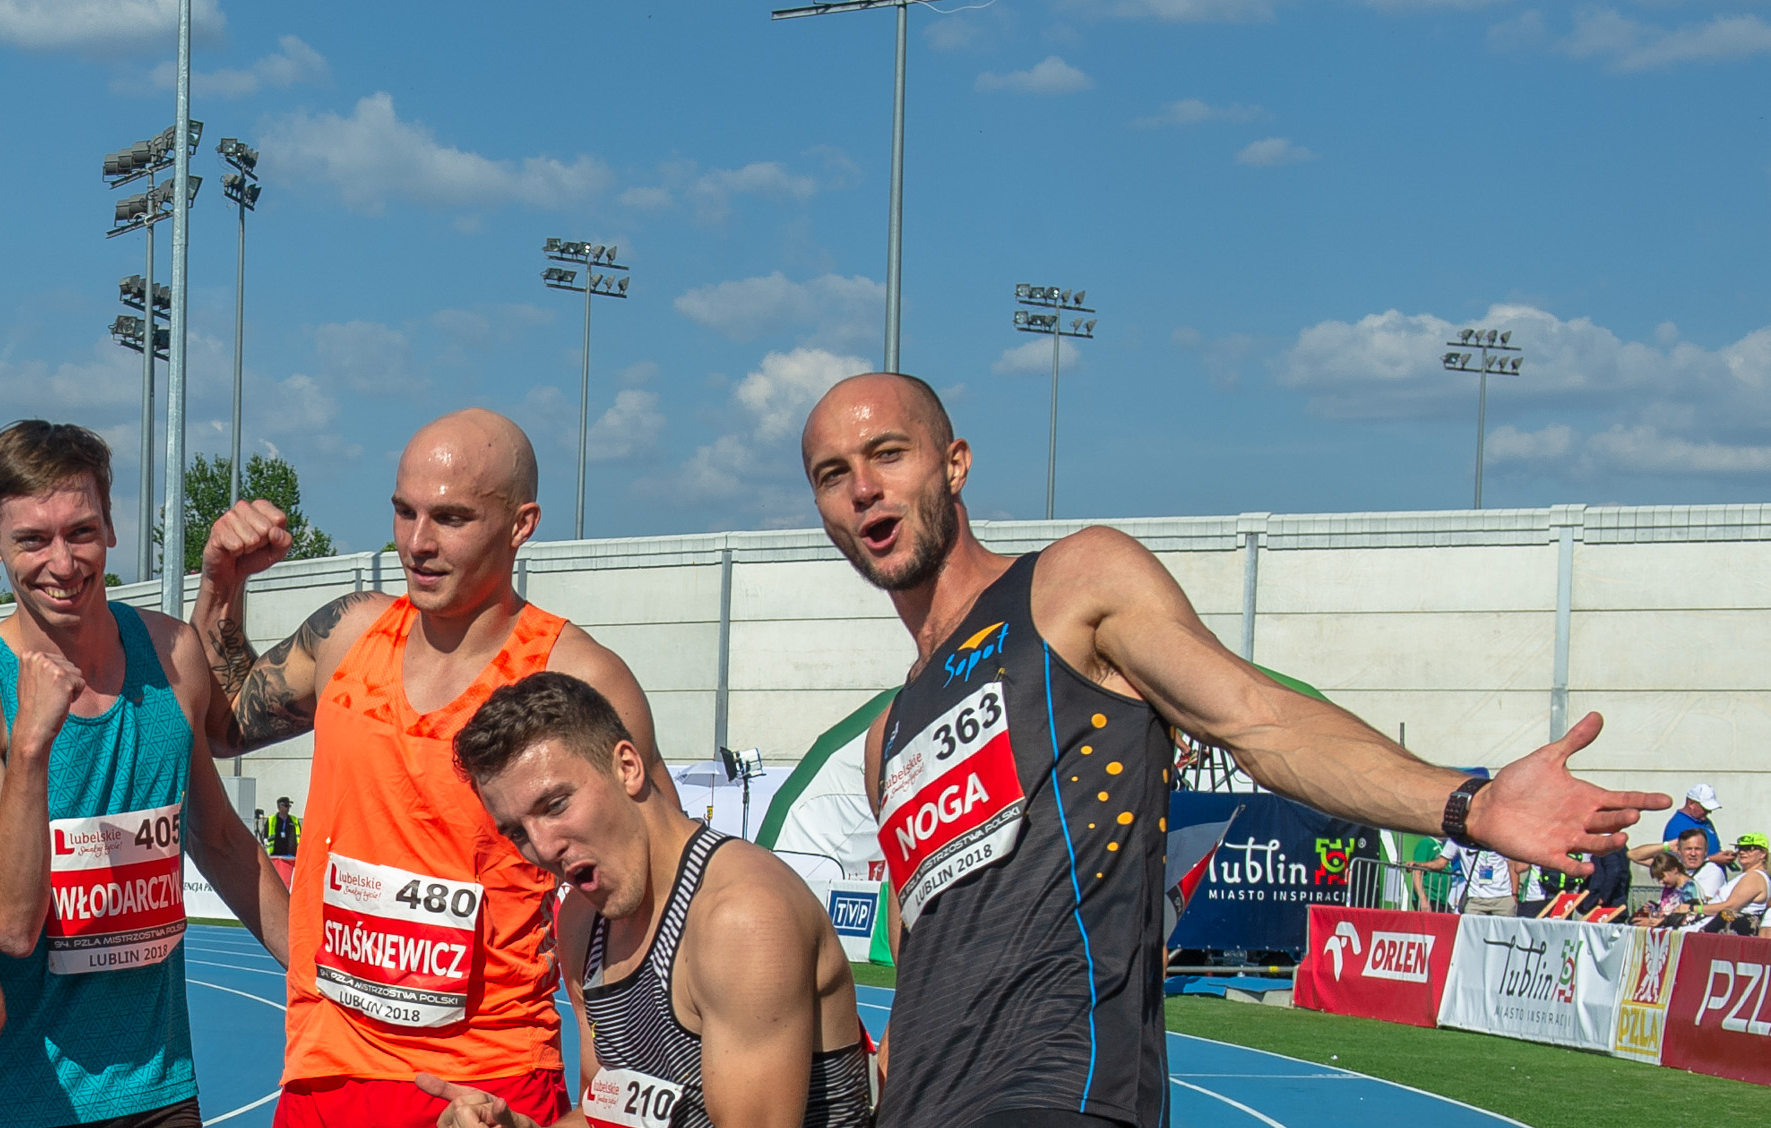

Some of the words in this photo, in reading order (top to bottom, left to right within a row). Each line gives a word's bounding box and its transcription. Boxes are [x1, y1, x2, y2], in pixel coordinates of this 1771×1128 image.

[943, 622, 1009, 689] Sopot
[932, 692, 1003, 761] 363
[134, 812, 180, 850] 405
[895, 771, 991, 862] NOGA
[984, 806, 1021, 834] POLSKI
[69, 829, 122, 845] lubelskie
[339, 869, 382, 891] lubelskie
[915, 864, 954, 907] LUBLIN
[956, 843, 993, 874] 2018
[51, 870, 183, 921] WŁODARCZYK
[395, 878, 477, 918] 480
[837, 902, 869, 925] TVP
[1208, 889, 1265, 901] MIASTO
[1273, 891, 1346, 903] INSPIRACJ
[54, 940, 71, 949] 94.
[73, 938, 101, 948] PZLA
[103, 927, 166, 945] MISTRZOSTWA
[89, 952, 140, 967] LUBLIN
[143, 944, 168, 961] 2018
[324, 919, 467, 979] STAŚKIEWICZ
[1371, 938, 1429, 976] ORLEN
[330, 971, 354, 986] PZLA
[354, 980, 418, 1001] MISTRZOSTWA
[419, 993, 459, 1006] POLSKI
[338, 990, 383, 1014] LUBLIN
[384, 1005, 421, 1023] 2018
[1694, 958, 1771, 1037] PZL
[1494, 1005, 1524, 1021] MIASTO
[1618, 1005, 1659, 1049] PZLA
[624, 1080, 676, 1121] 210
